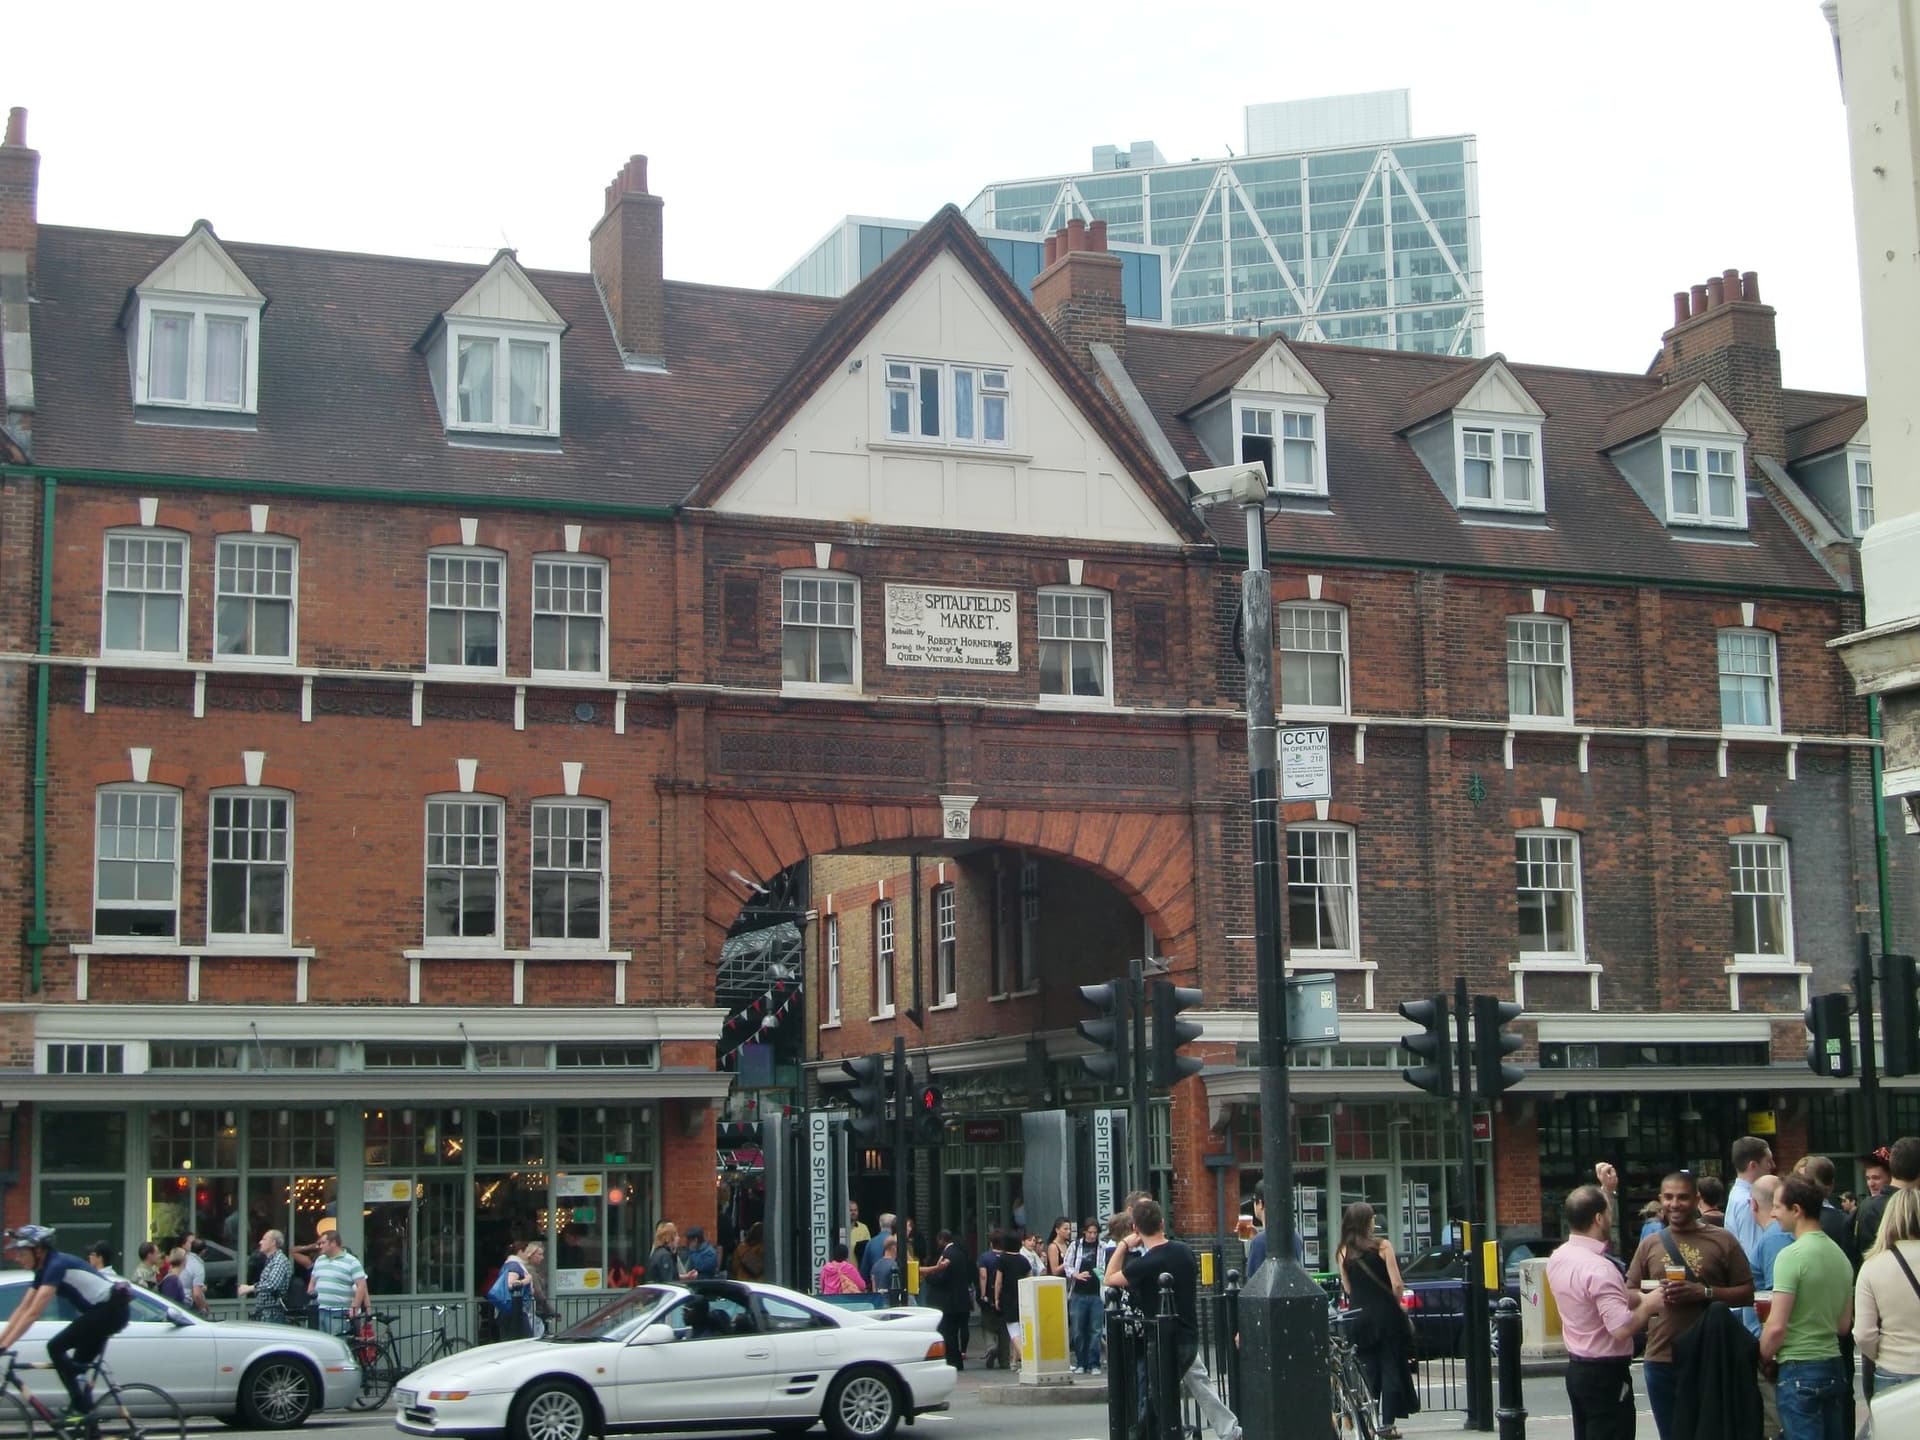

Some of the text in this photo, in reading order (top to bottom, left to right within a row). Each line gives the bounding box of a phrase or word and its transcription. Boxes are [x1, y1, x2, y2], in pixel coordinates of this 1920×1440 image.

[925, 593, 1011, 612] SPITALFIELDS
[940, 612, 1000, 631] MARKET.
[891, 627, 926, 638] Rebuilt by
[891, 642, 913, 653] During
[927, 645, 943, 653] year
[927, 635, 958, 646] ROBERT
[960, 636, 994, 648] HORNER
[897, 652, 922, 662] QUEEN
[965, 656, 994, 666] JUBILEE
[1283, 731, 1325, 745] CCTV
[1290, 744, 1327, 752] OPERATION
[812, 1119, 825, 1152] OLD
[1097, 1116, 1110, 1185] SPITFIRE
[71, 1196, 90, 1206] 103
[813, 1157, 826, 1268] SPITALFIELDS
